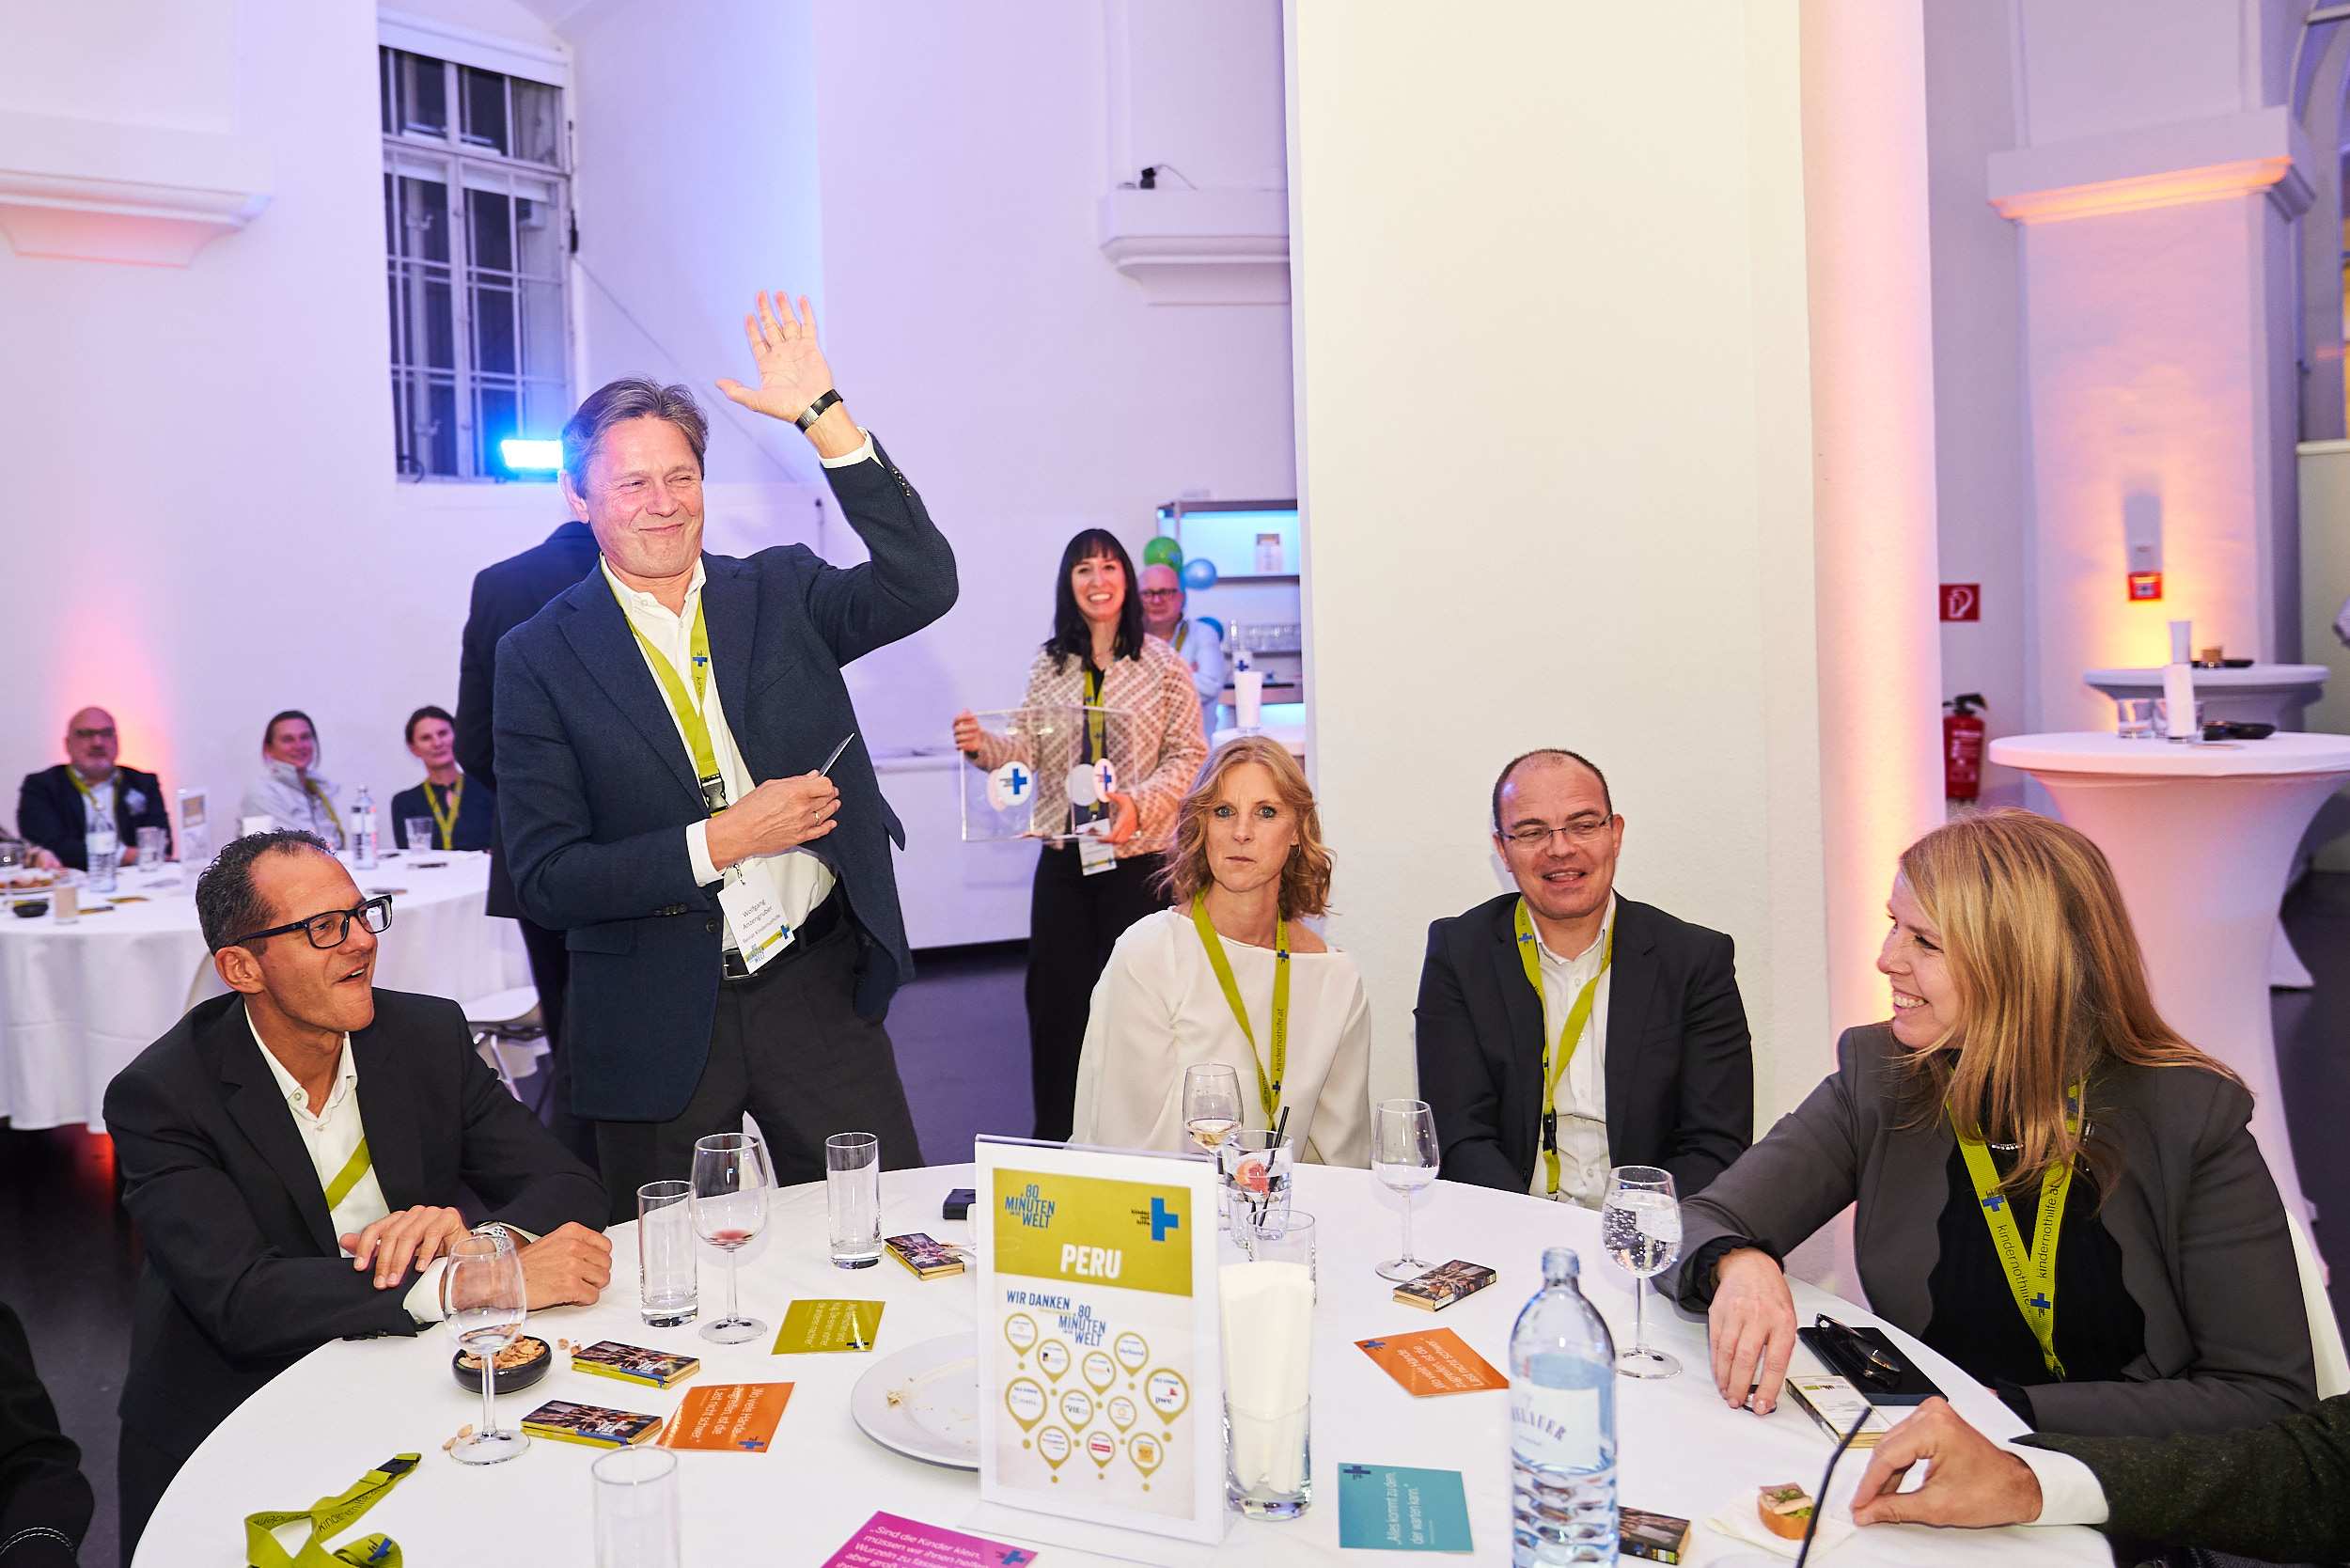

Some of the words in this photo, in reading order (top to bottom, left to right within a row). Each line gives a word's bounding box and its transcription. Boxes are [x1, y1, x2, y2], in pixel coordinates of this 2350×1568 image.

[1026, 1184, 1040, 1200] 80
[1005, 1195, 1056, 1216] MINUTEN
[1022, 1210, 1051, 1230] WELT
[1059, 1243, 1122, 1279] PERU
[1007, 1289, 1026, 1306] WIR
[1028, 1293, 1071, 1311] DANKEN
[1077, 1303, 1092, 1319] 80
[1058, 1314, 1106, 1335] MINUTEN
[1074, 1330, 1103, 1348] WELT
[1462, 1372, 1485, 1387] Last
[711, 1388, 728, 1400] Last
[863, 1535, 905, 1550] müssen
[900, 1531, 917, 1543] die
[917, 1538, 954, 1551] Kinder
[854, 1543, 898, 1560] Wurzeln
